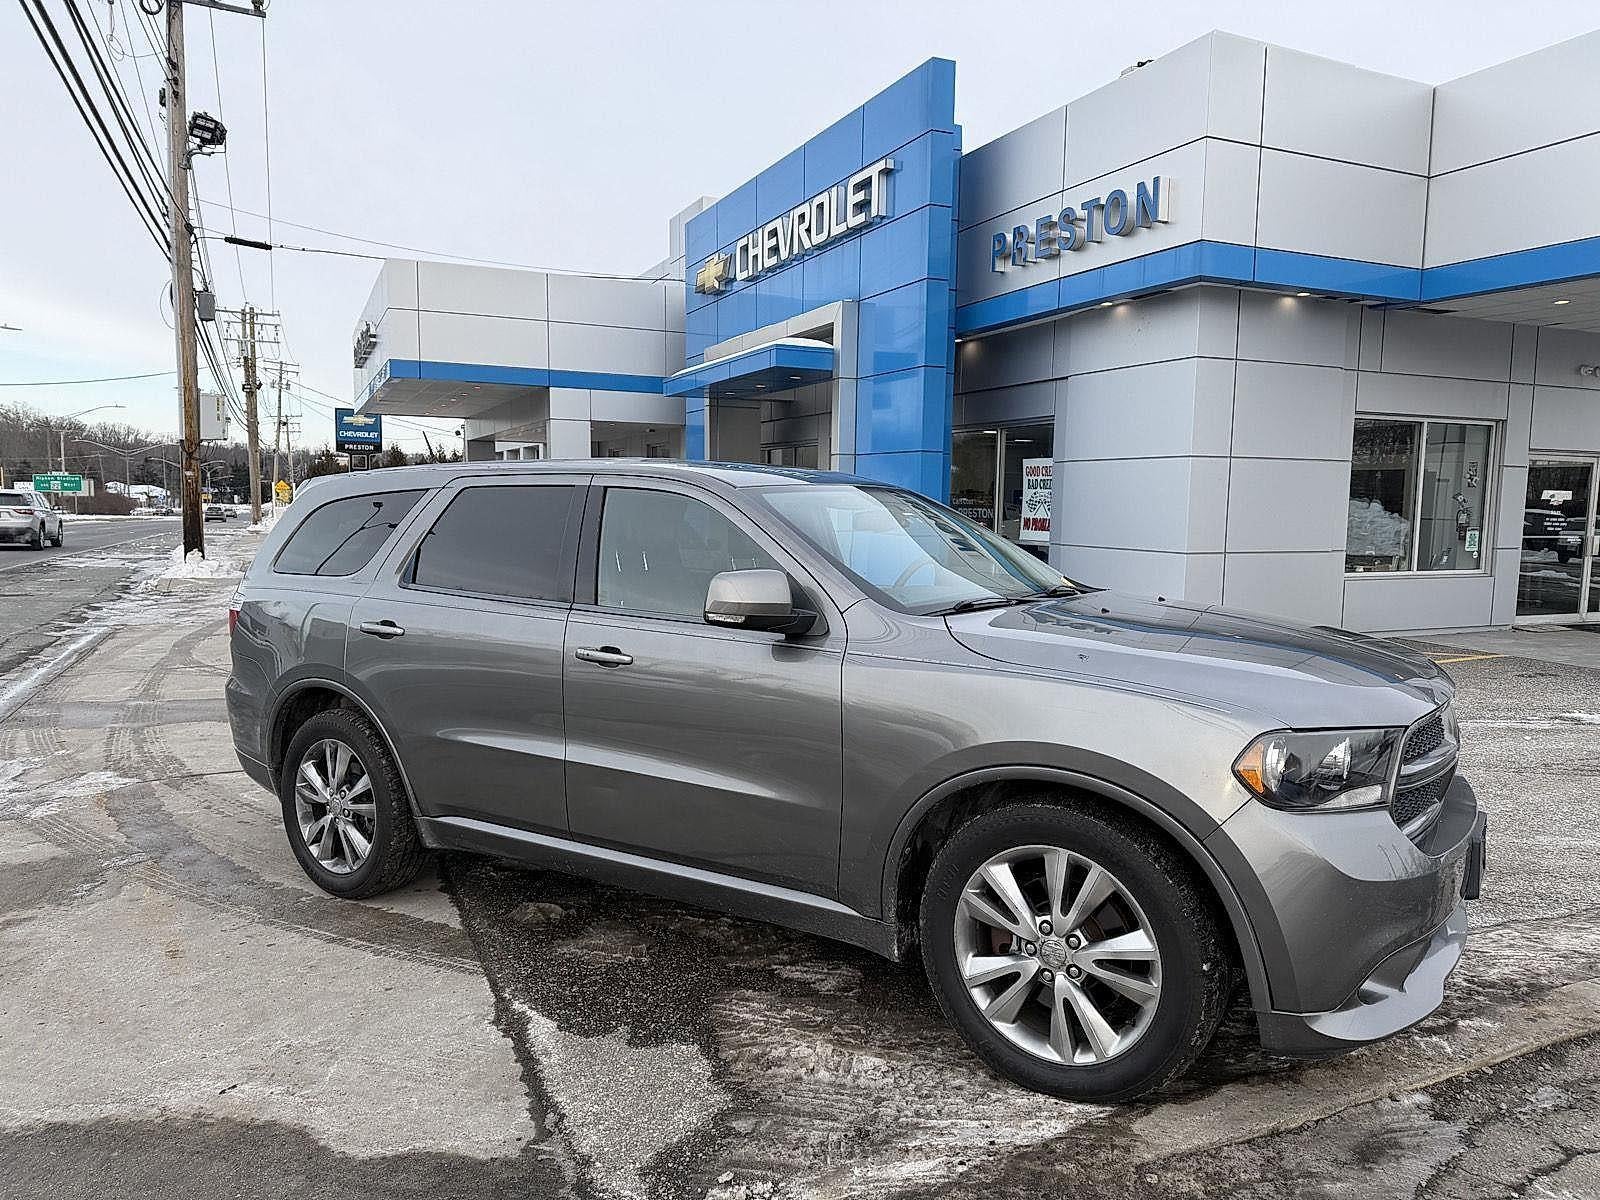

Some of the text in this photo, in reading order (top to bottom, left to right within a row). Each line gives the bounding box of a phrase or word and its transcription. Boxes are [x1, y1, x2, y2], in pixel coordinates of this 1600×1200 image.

[735, 158, 894, 282] CHEVROLET
[991, 176, 1169, 273] PRESTON
[339, 430, 379, 438] CHEVROLET
[1025, 466, 1040, 477] GOOD
[1027, 479, 1038, 489] BAD
[1023, 517, 1031, 531] NO
